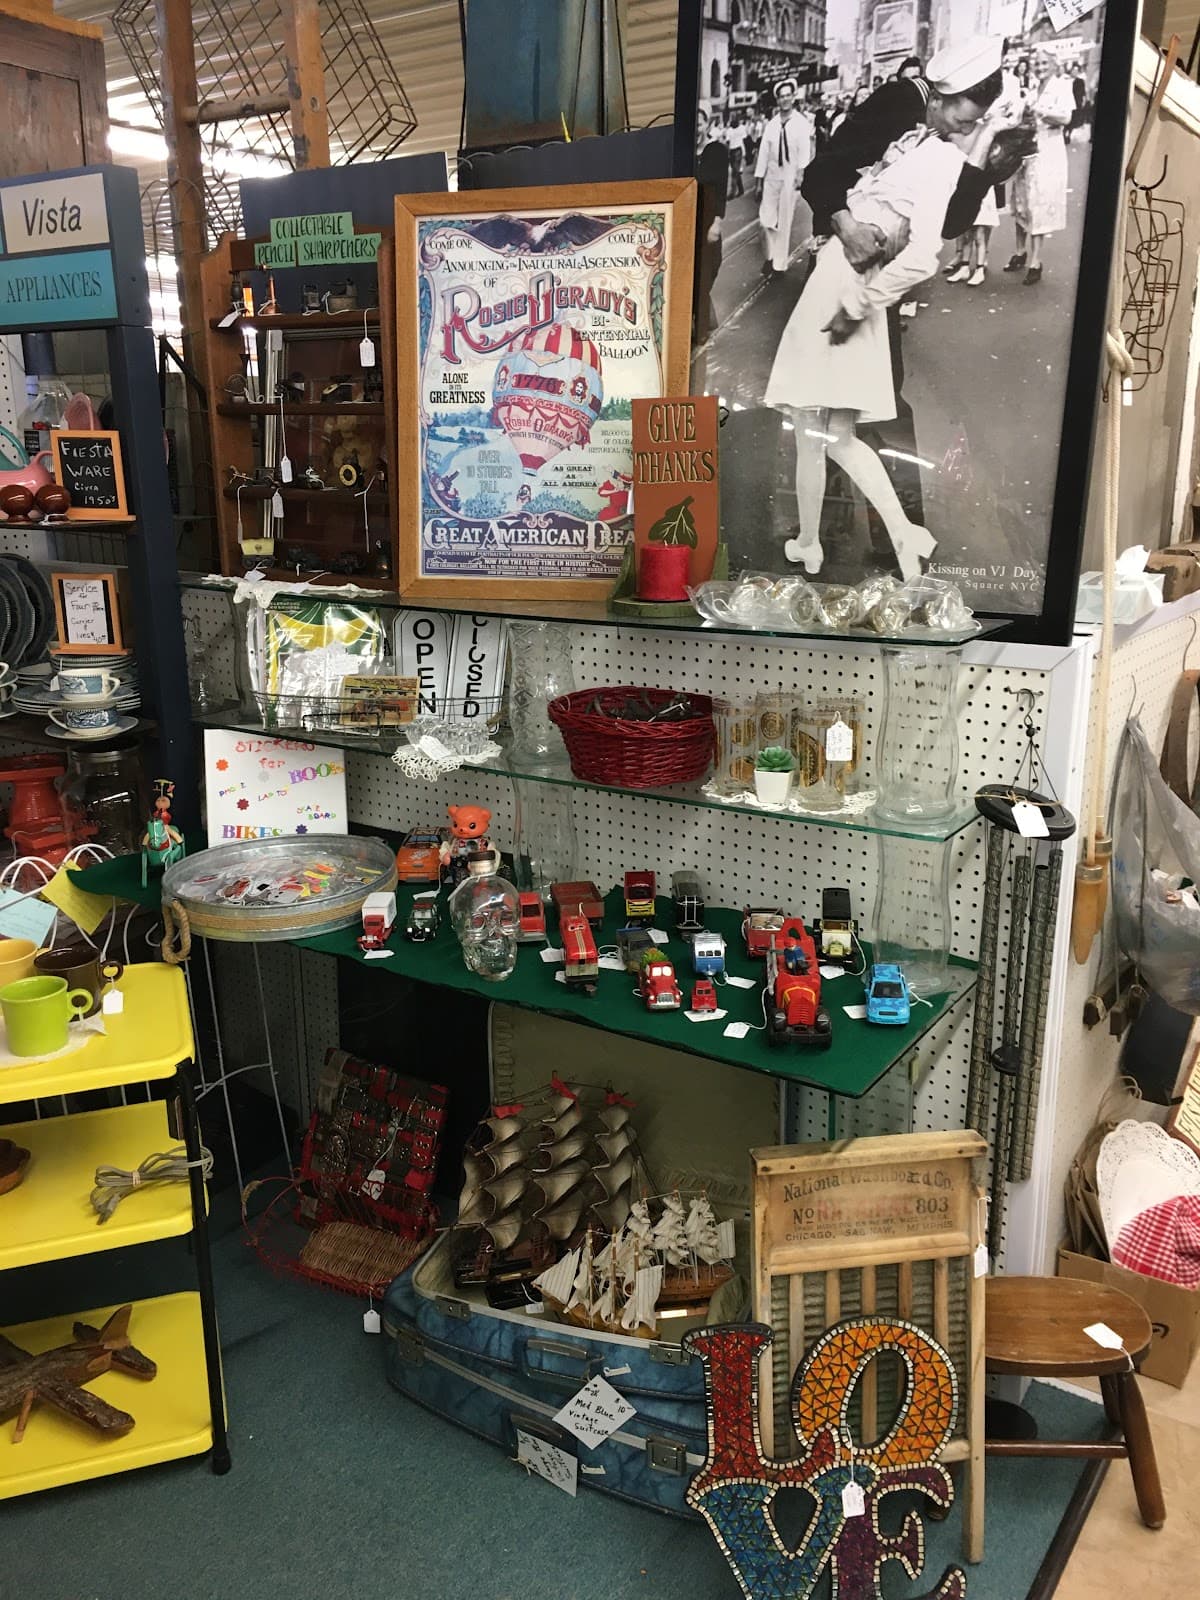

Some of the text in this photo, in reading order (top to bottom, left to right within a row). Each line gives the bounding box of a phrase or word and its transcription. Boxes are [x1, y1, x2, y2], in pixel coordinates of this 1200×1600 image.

[23, 197, 82, 236] Vista
[275, 216, 344, 239] COLLECTABLE
[429, 239, 473, 250] COME ONE
[608, 232, 653, 244] COME ALL
[258, 237, 376, 263] PENCIL SHARPENERS
[443, 260, 509, 273] ANNOUNCING
[518, 257, 581, 271] INAUGURAL
[580, 256, 641, 269] ASCENSION
[6, 271, 102, 303] APPLIANCES
[483, 278, 498, 288] OF
[441, 271, 637, 364] ROSIE O'GRADY'S
[591, 315, 610, 326] BI-
[598, 343, 649, 359] BALLOON
[442, 373, 469, 383] ALONE
[429, 390, 486, 404] GREATNESS
[648, 402, 697, 443] GIVE
[61, 441, 113, 458] FIESTA
[66, 464, 111, 477] WARE
[635, 449, 715, 484] THANKS
[424, 518, 635, 553] GREAT AMERICAN DREA
[928, 562, 969, 578] Kissing
[972, 568, 987, 576] on
[991, 565, 1006, 577] VJ
[65, 582, 98, 595] Service
[965, 580, 1005, 590] Square
[1010, 582, 1038, 591] NYC
[413, 618, 436, 714] OPEN
[259, 757, 285, 768] for
[219, 782, 247, 797] PHOE
[222, 824, 283, 839] BIKES
[934, 1170, 955, 1192] Co.
[915, 1196, 949, 1214] 803
[569, 1409, 599, 1426] Vintage
[575, 1398, 616, 1421] Med Blue
[574, 1422, 610, 1437] Suitcase
